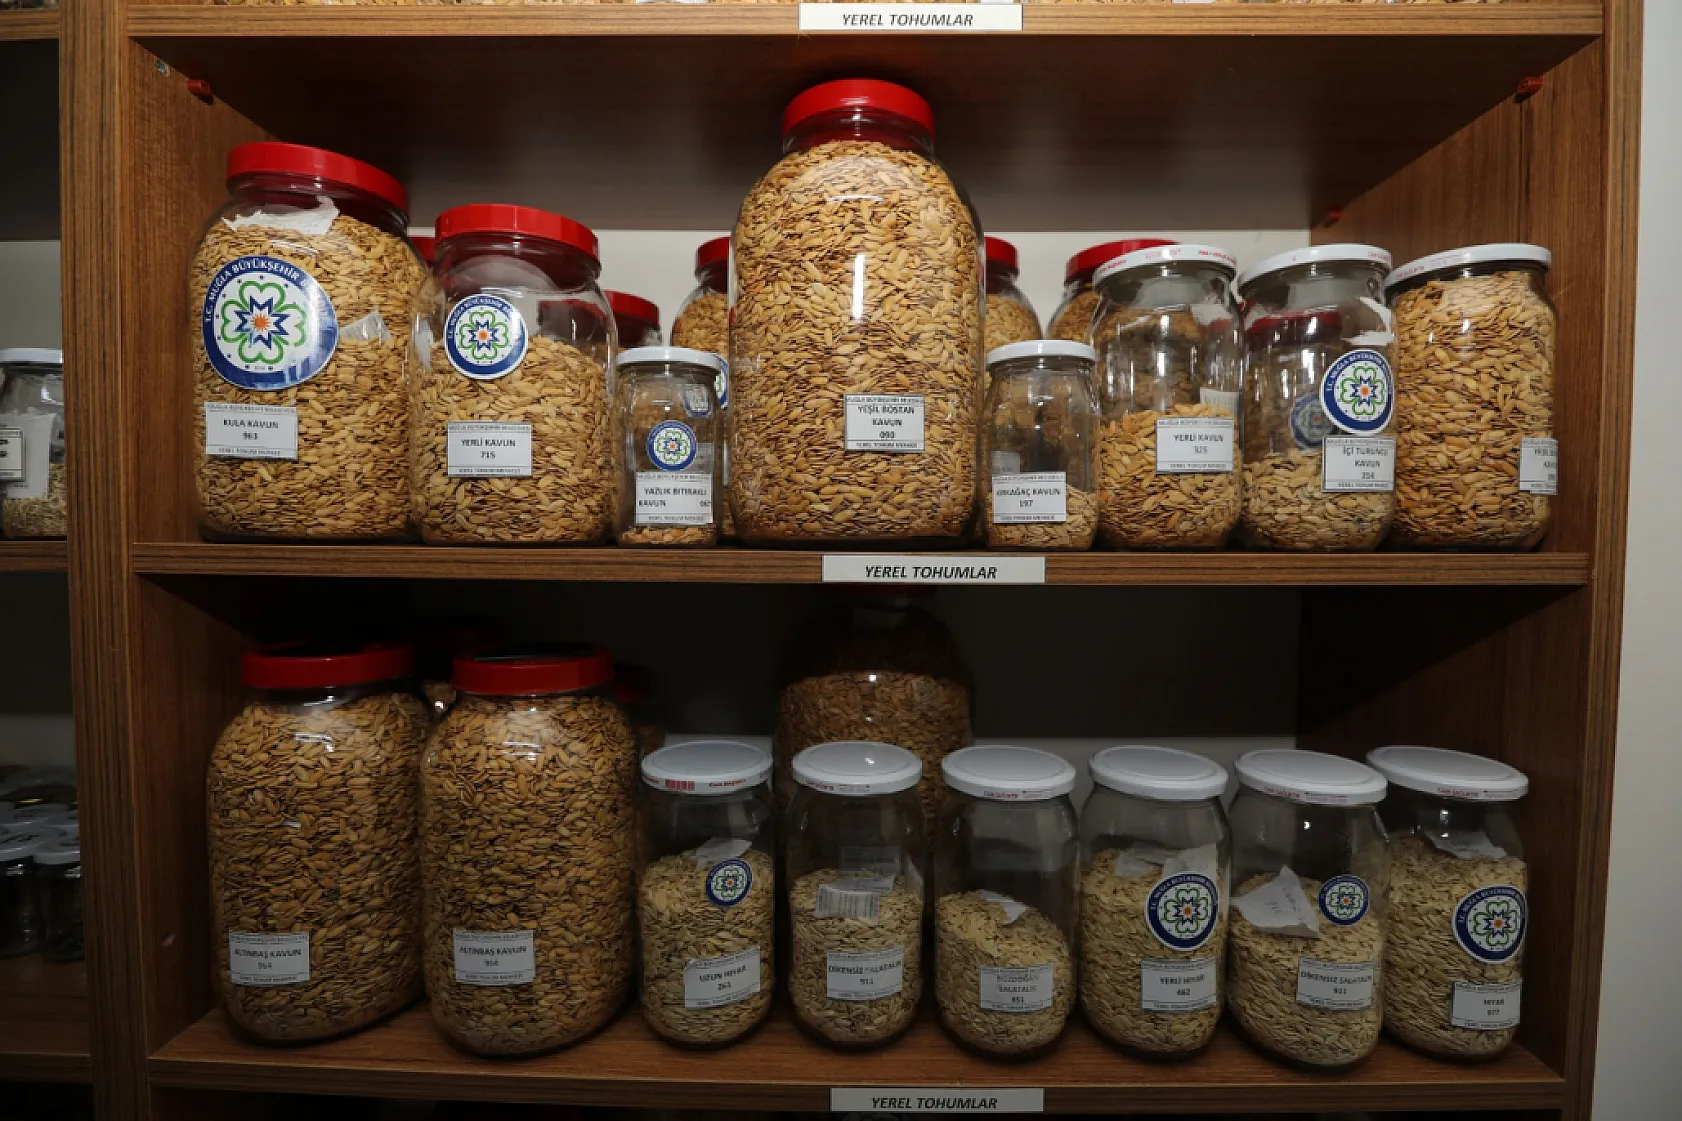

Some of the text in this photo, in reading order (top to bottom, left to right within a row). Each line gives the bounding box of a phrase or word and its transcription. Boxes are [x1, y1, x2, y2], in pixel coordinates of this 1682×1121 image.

[842, 14, 974, 27] YEREL TOHUMLAR
[858, 404, 880, 415] YEŞİL
[223, 419, 279, 429] KULA KAVUN
[460, 437, 516, 447] YERLİ KAVUN
[1197, 434, 1224, 443] KAVUN
[480, 451, 496, 459] 715
[1354, 460, 1381, 468] KAVUN
[1032, 488, 1061, 496] KAVUN
[638, 499, 666, 508] KAVUN
[865, 565, 998, 579] YEREL TOHUMLAR
[269, 948, 302, 957] KAVUN
[496, 946, 527, 955] KAVUN
[1159, 976, 1182, 985] YERLİ
[871, 1098, 998, 1109] YEREL TOHUMLAR
